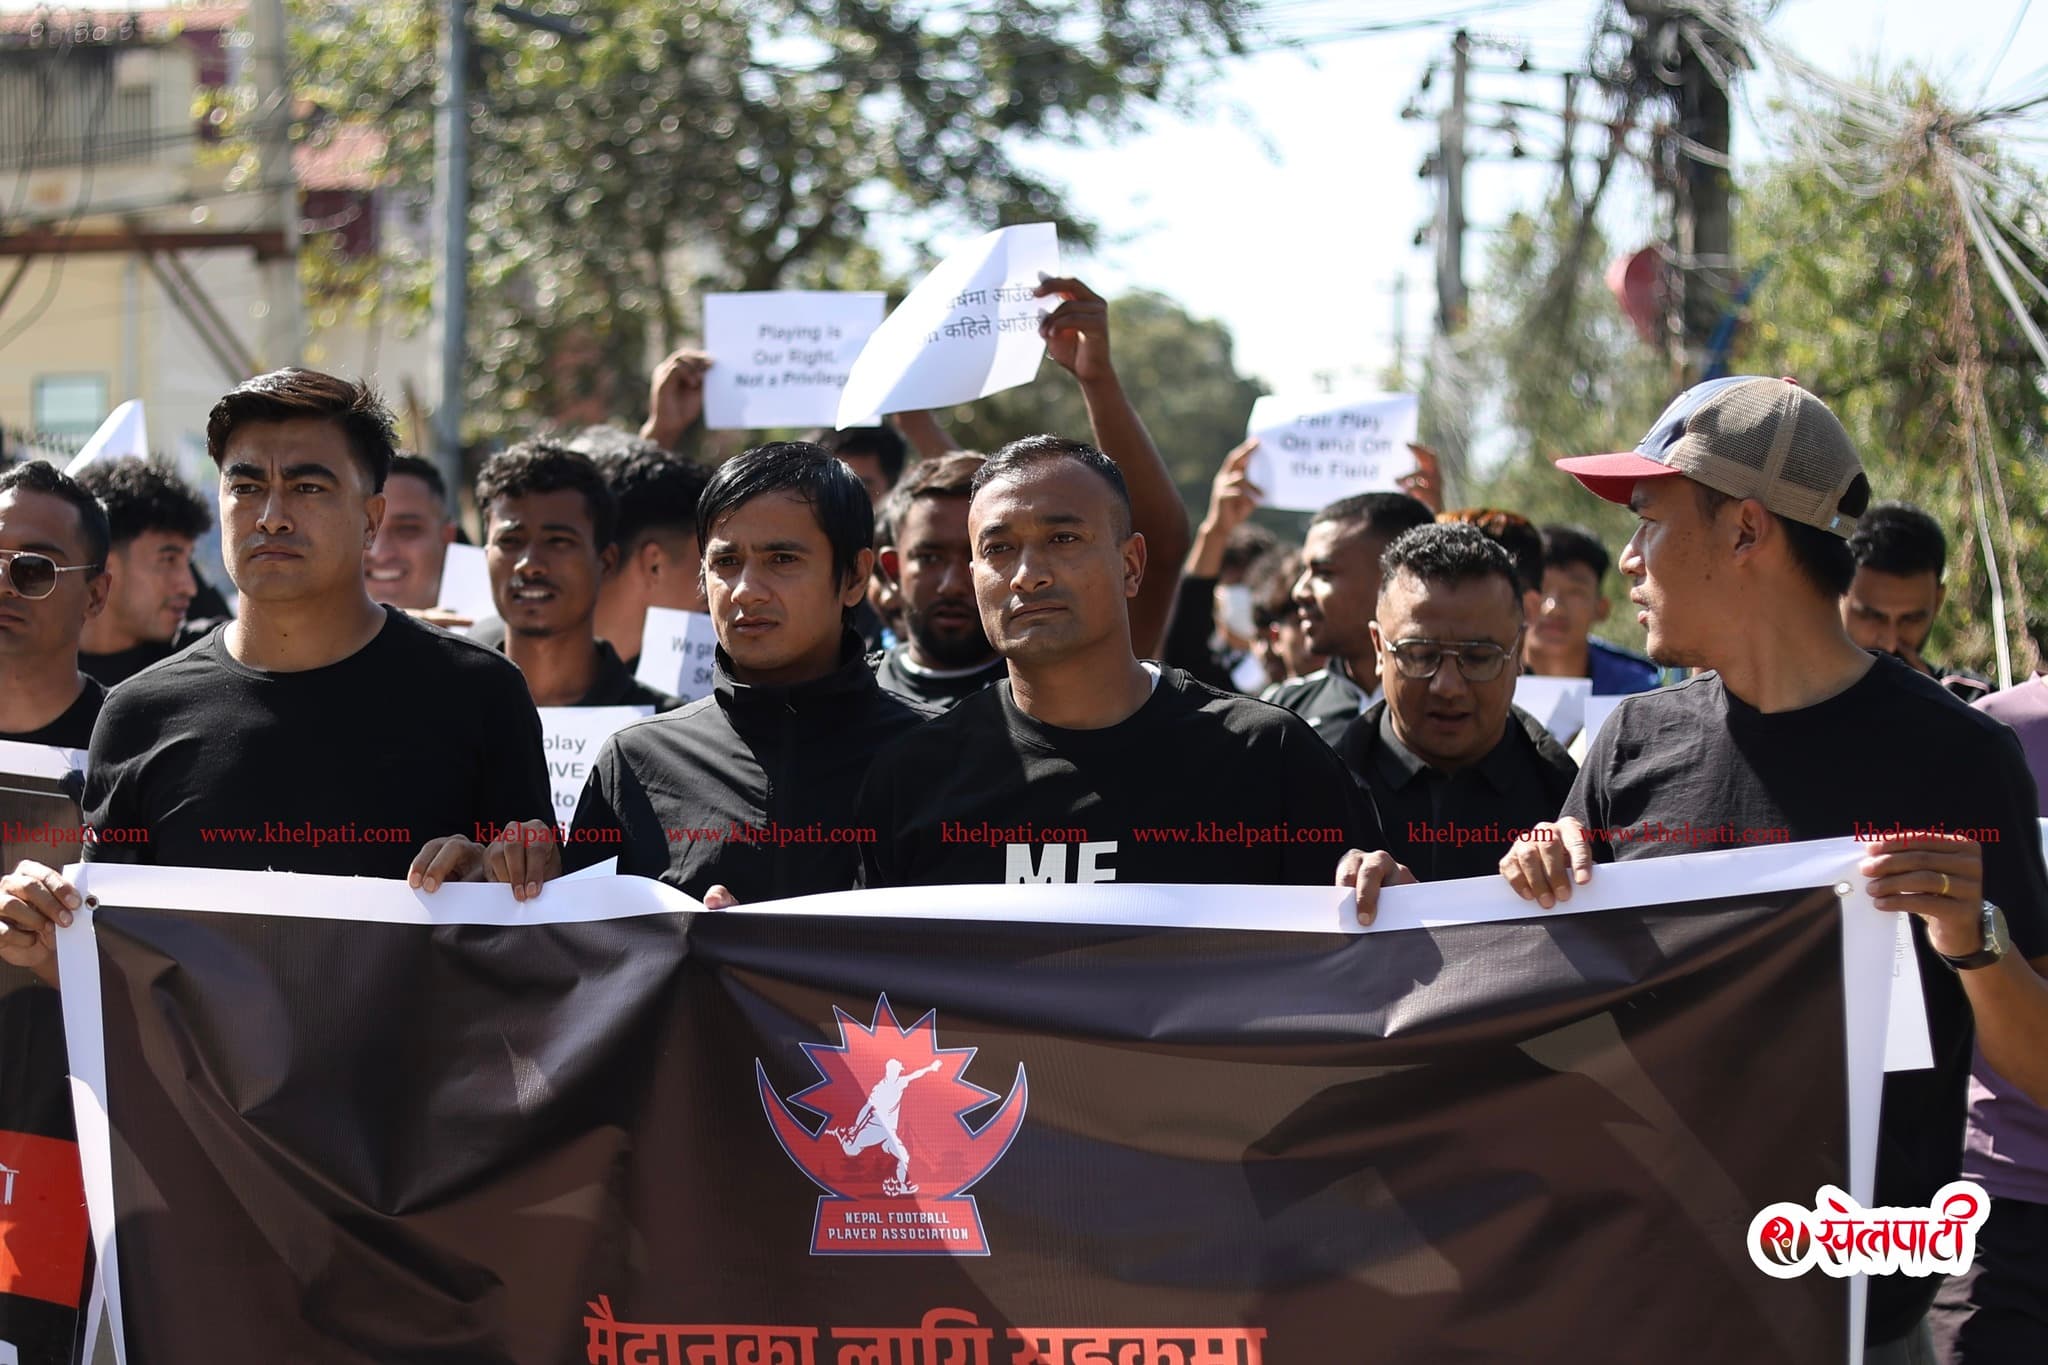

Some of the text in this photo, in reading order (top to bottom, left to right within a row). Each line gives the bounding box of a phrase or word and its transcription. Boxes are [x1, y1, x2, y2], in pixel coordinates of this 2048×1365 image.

[758, 324, 822, 342] Playing
[943, 313, 992, 340] कहिले
[752, 349, 783, 365] Our
[735, 370, 849, 389] Not a Privileg
[1339, 411, 1381, 431] Play
[1280, 432, 1312, 451] On
[1318, 434, 1357, 453] and
[548, 761, 585, 779] IVE
[845, 1212, 950, 1224] NEPAL FOOTBALL
[827, 1228, 968, 1240] PLAYER ASSOCIATION
